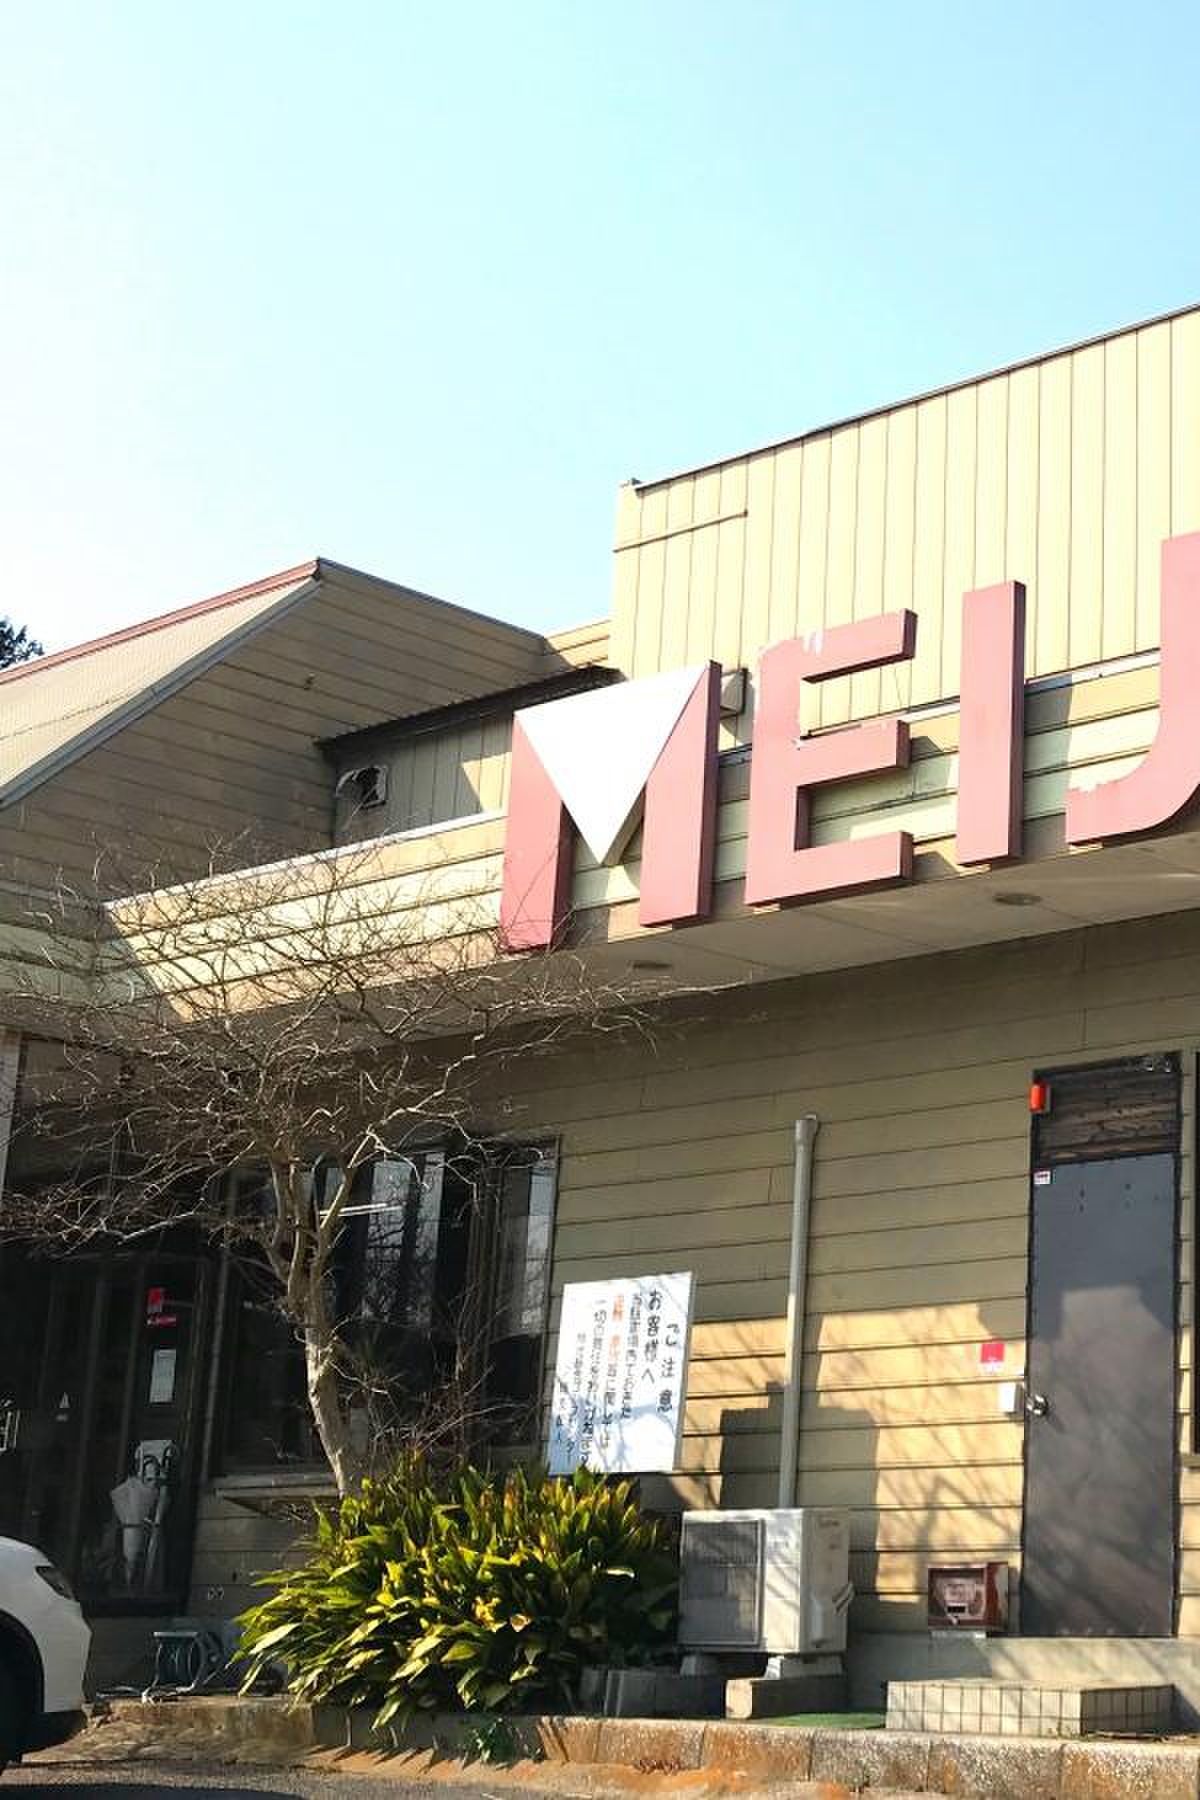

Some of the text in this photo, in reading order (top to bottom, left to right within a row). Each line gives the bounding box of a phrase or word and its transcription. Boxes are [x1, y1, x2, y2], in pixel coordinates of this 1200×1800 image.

[640, 1289, 664, 1384] お客様へ
[657, 1322, 681, 1414] ご注意
